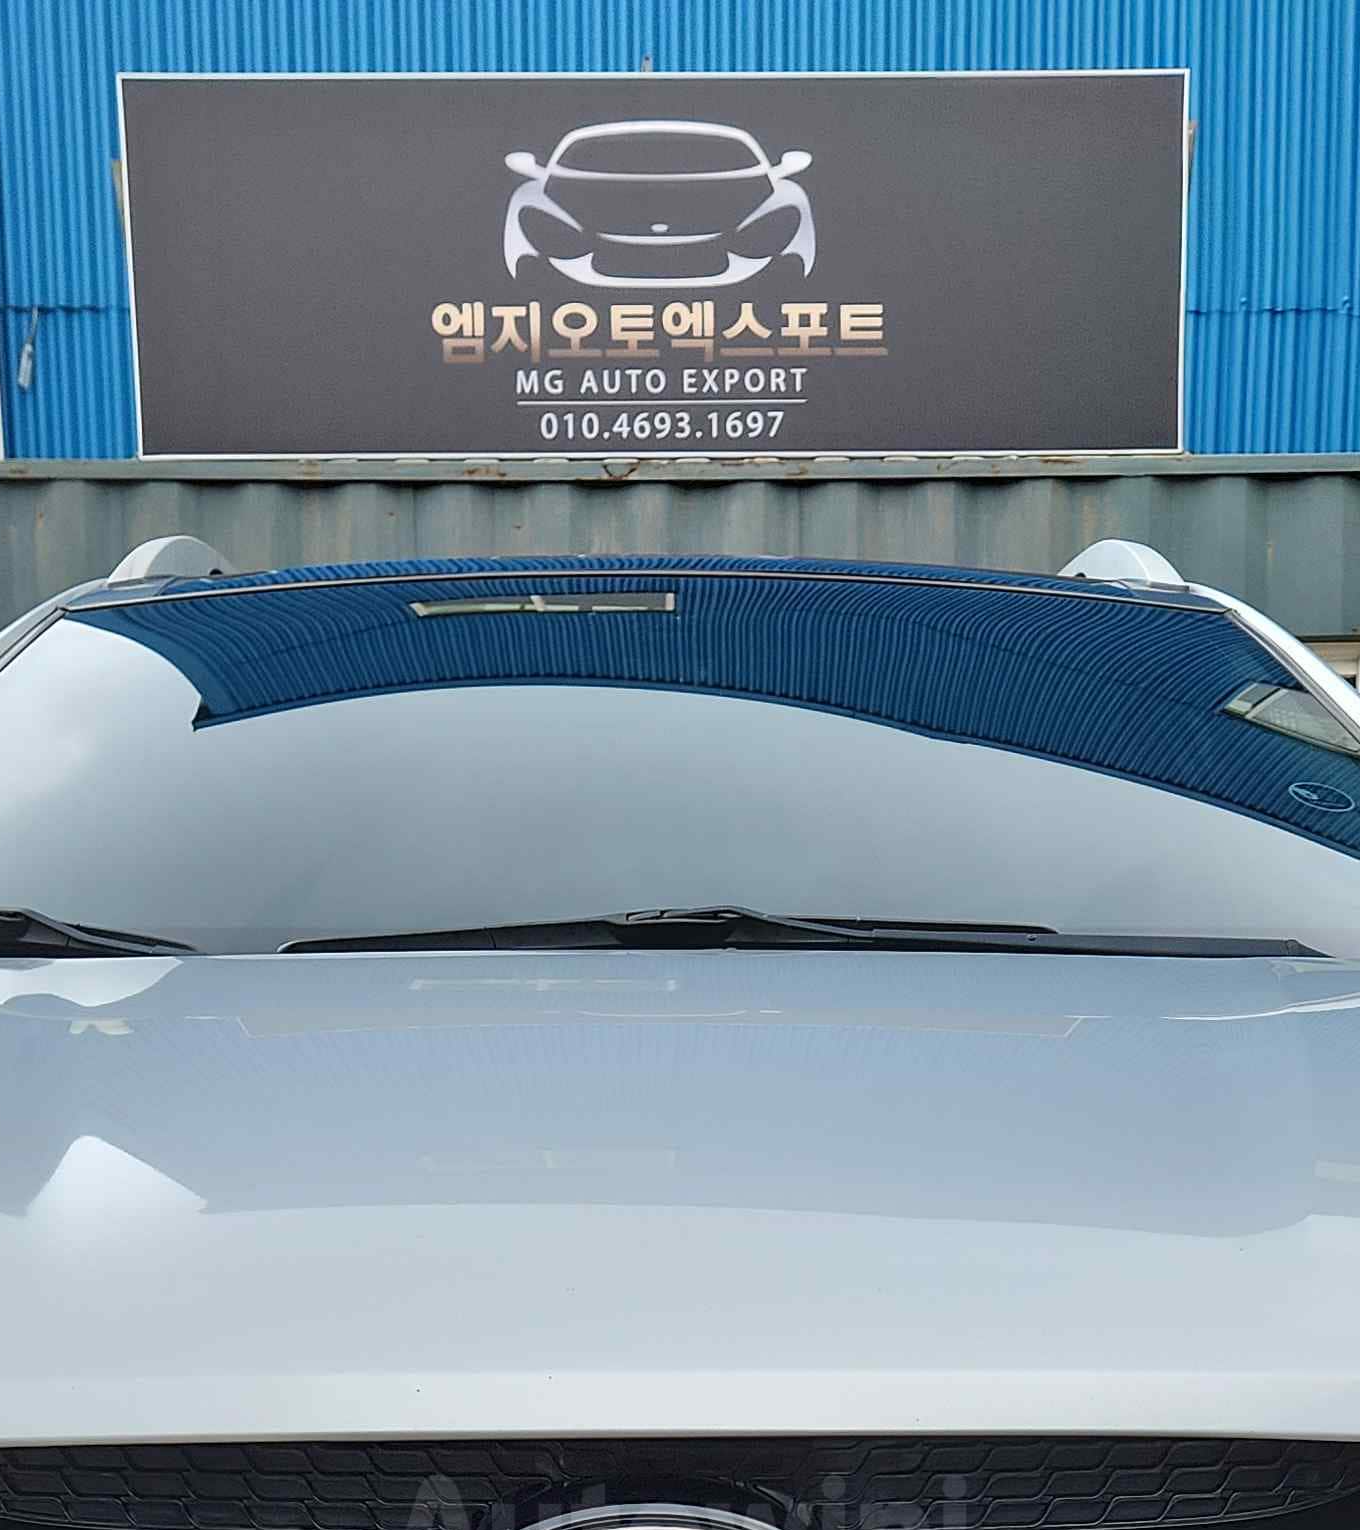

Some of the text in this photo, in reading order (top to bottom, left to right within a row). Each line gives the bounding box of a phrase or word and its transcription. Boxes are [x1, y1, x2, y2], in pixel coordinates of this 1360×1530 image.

[431, 300, 889, 363] 엠지오토엑스포트
[515, 367, 809, 395] MG AUTO EXPORT
[539, 410, 785, 440] 010.4693.1697
